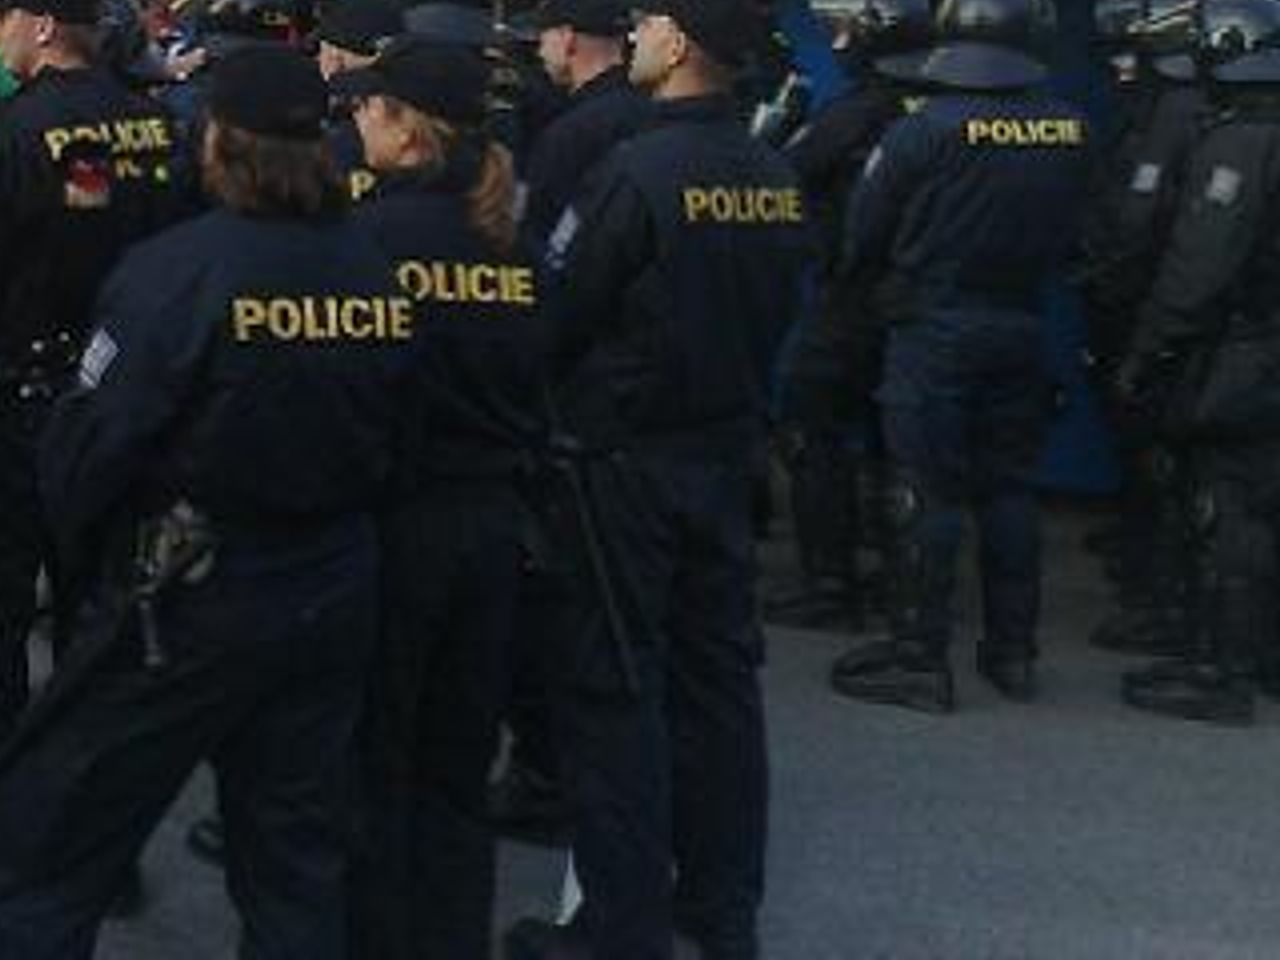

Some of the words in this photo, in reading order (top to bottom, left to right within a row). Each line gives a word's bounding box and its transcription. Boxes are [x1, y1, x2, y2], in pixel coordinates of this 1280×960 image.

[967, 118, 1082, 146] POLICIE
[683, 186, 803, 223] POLICIE
[396, 260, 536, 306] OLICIE
[232, 295, 414, 341] POLICIE
